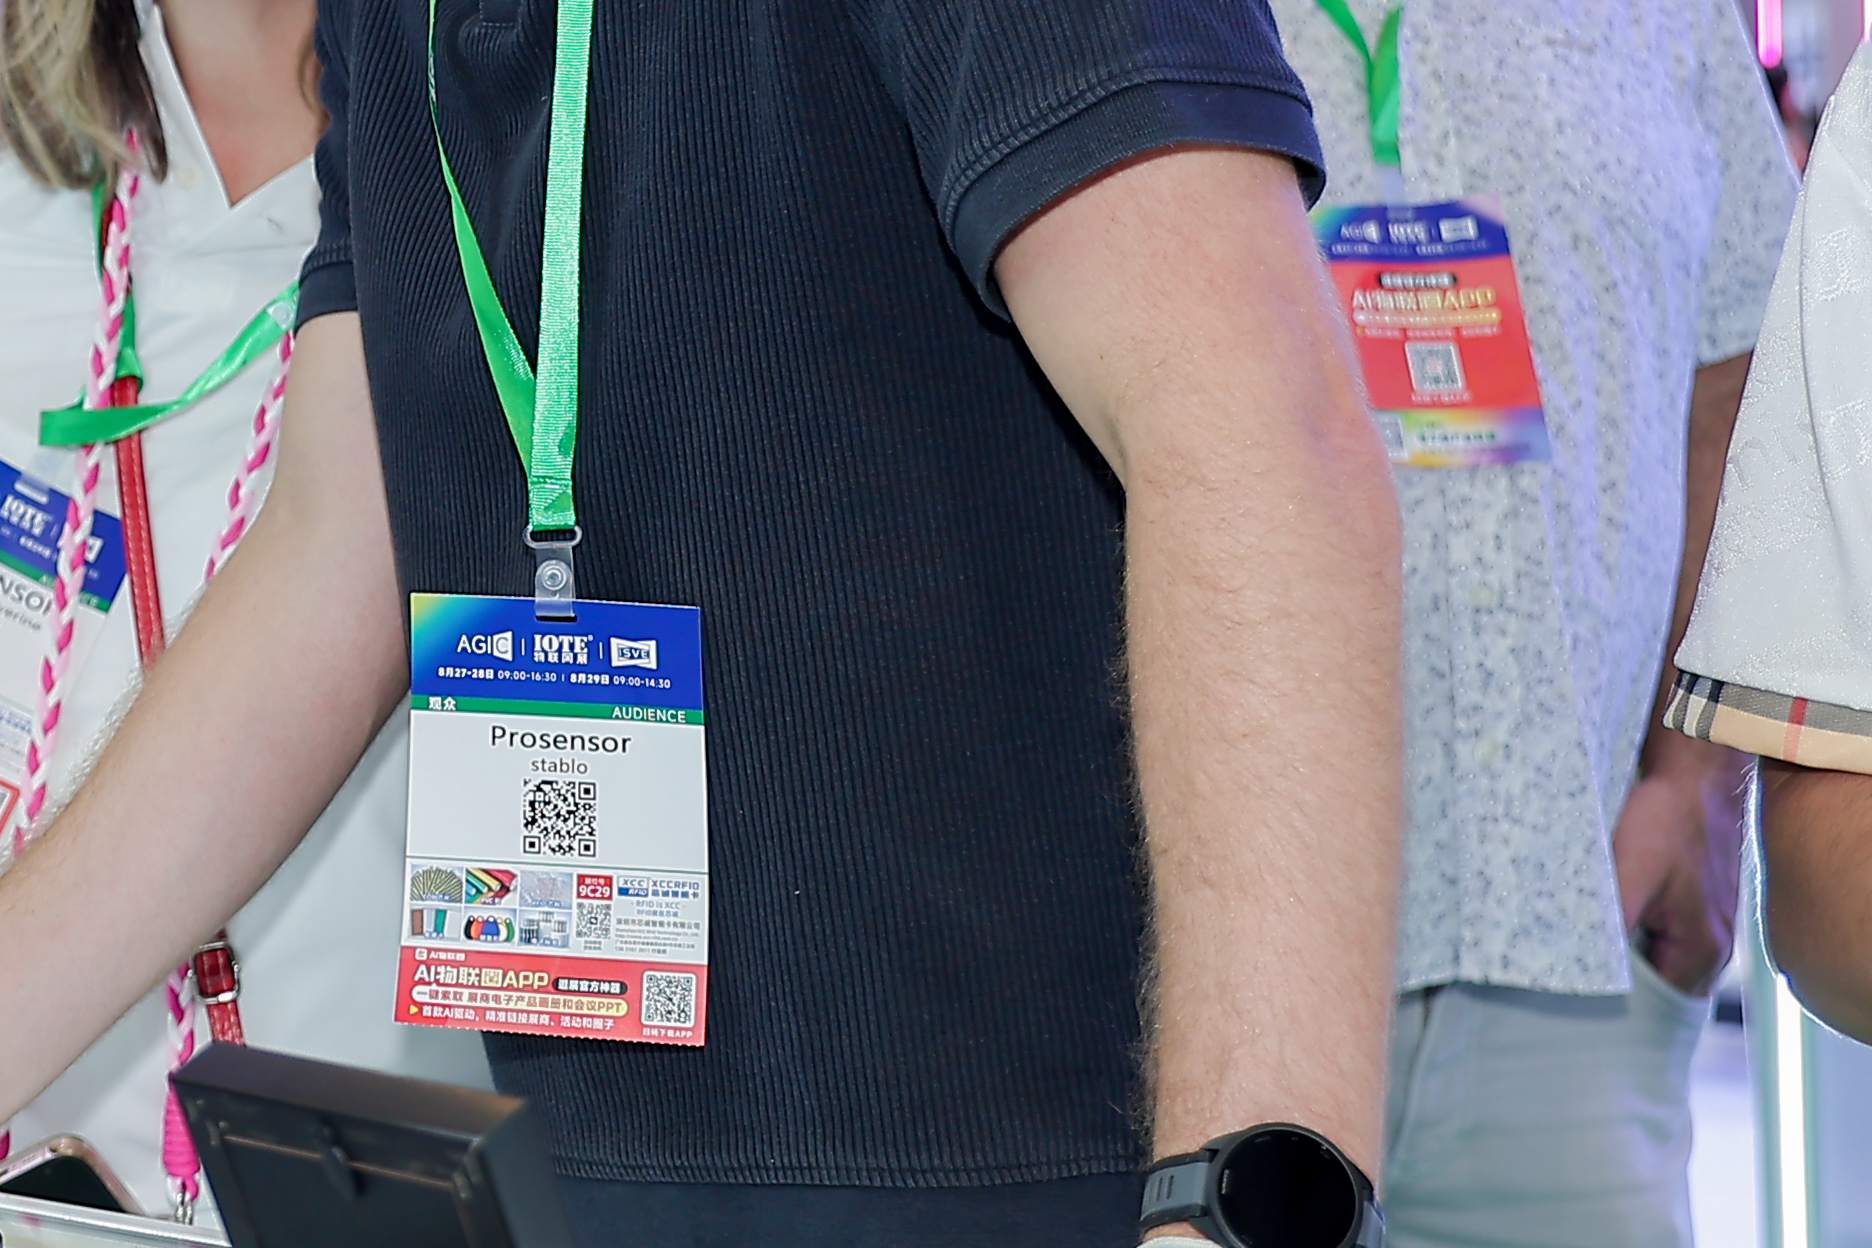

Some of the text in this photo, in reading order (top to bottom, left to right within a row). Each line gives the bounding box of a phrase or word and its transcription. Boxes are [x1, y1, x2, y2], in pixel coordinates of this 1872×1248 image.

[438, 667, 494, 680] 8月27-28日
[570, 673, 610, 685] 8月29日
[429, 696, 456, 711] 观众
[612, 706, 687, 723] AUDIENCE
[491, 725, 632, 753] Prosensor
[531, 758, 588, 774] stablo
[579, 885, 610, 898] 9C29
[651, 879, 700, 890] XCCRFID
